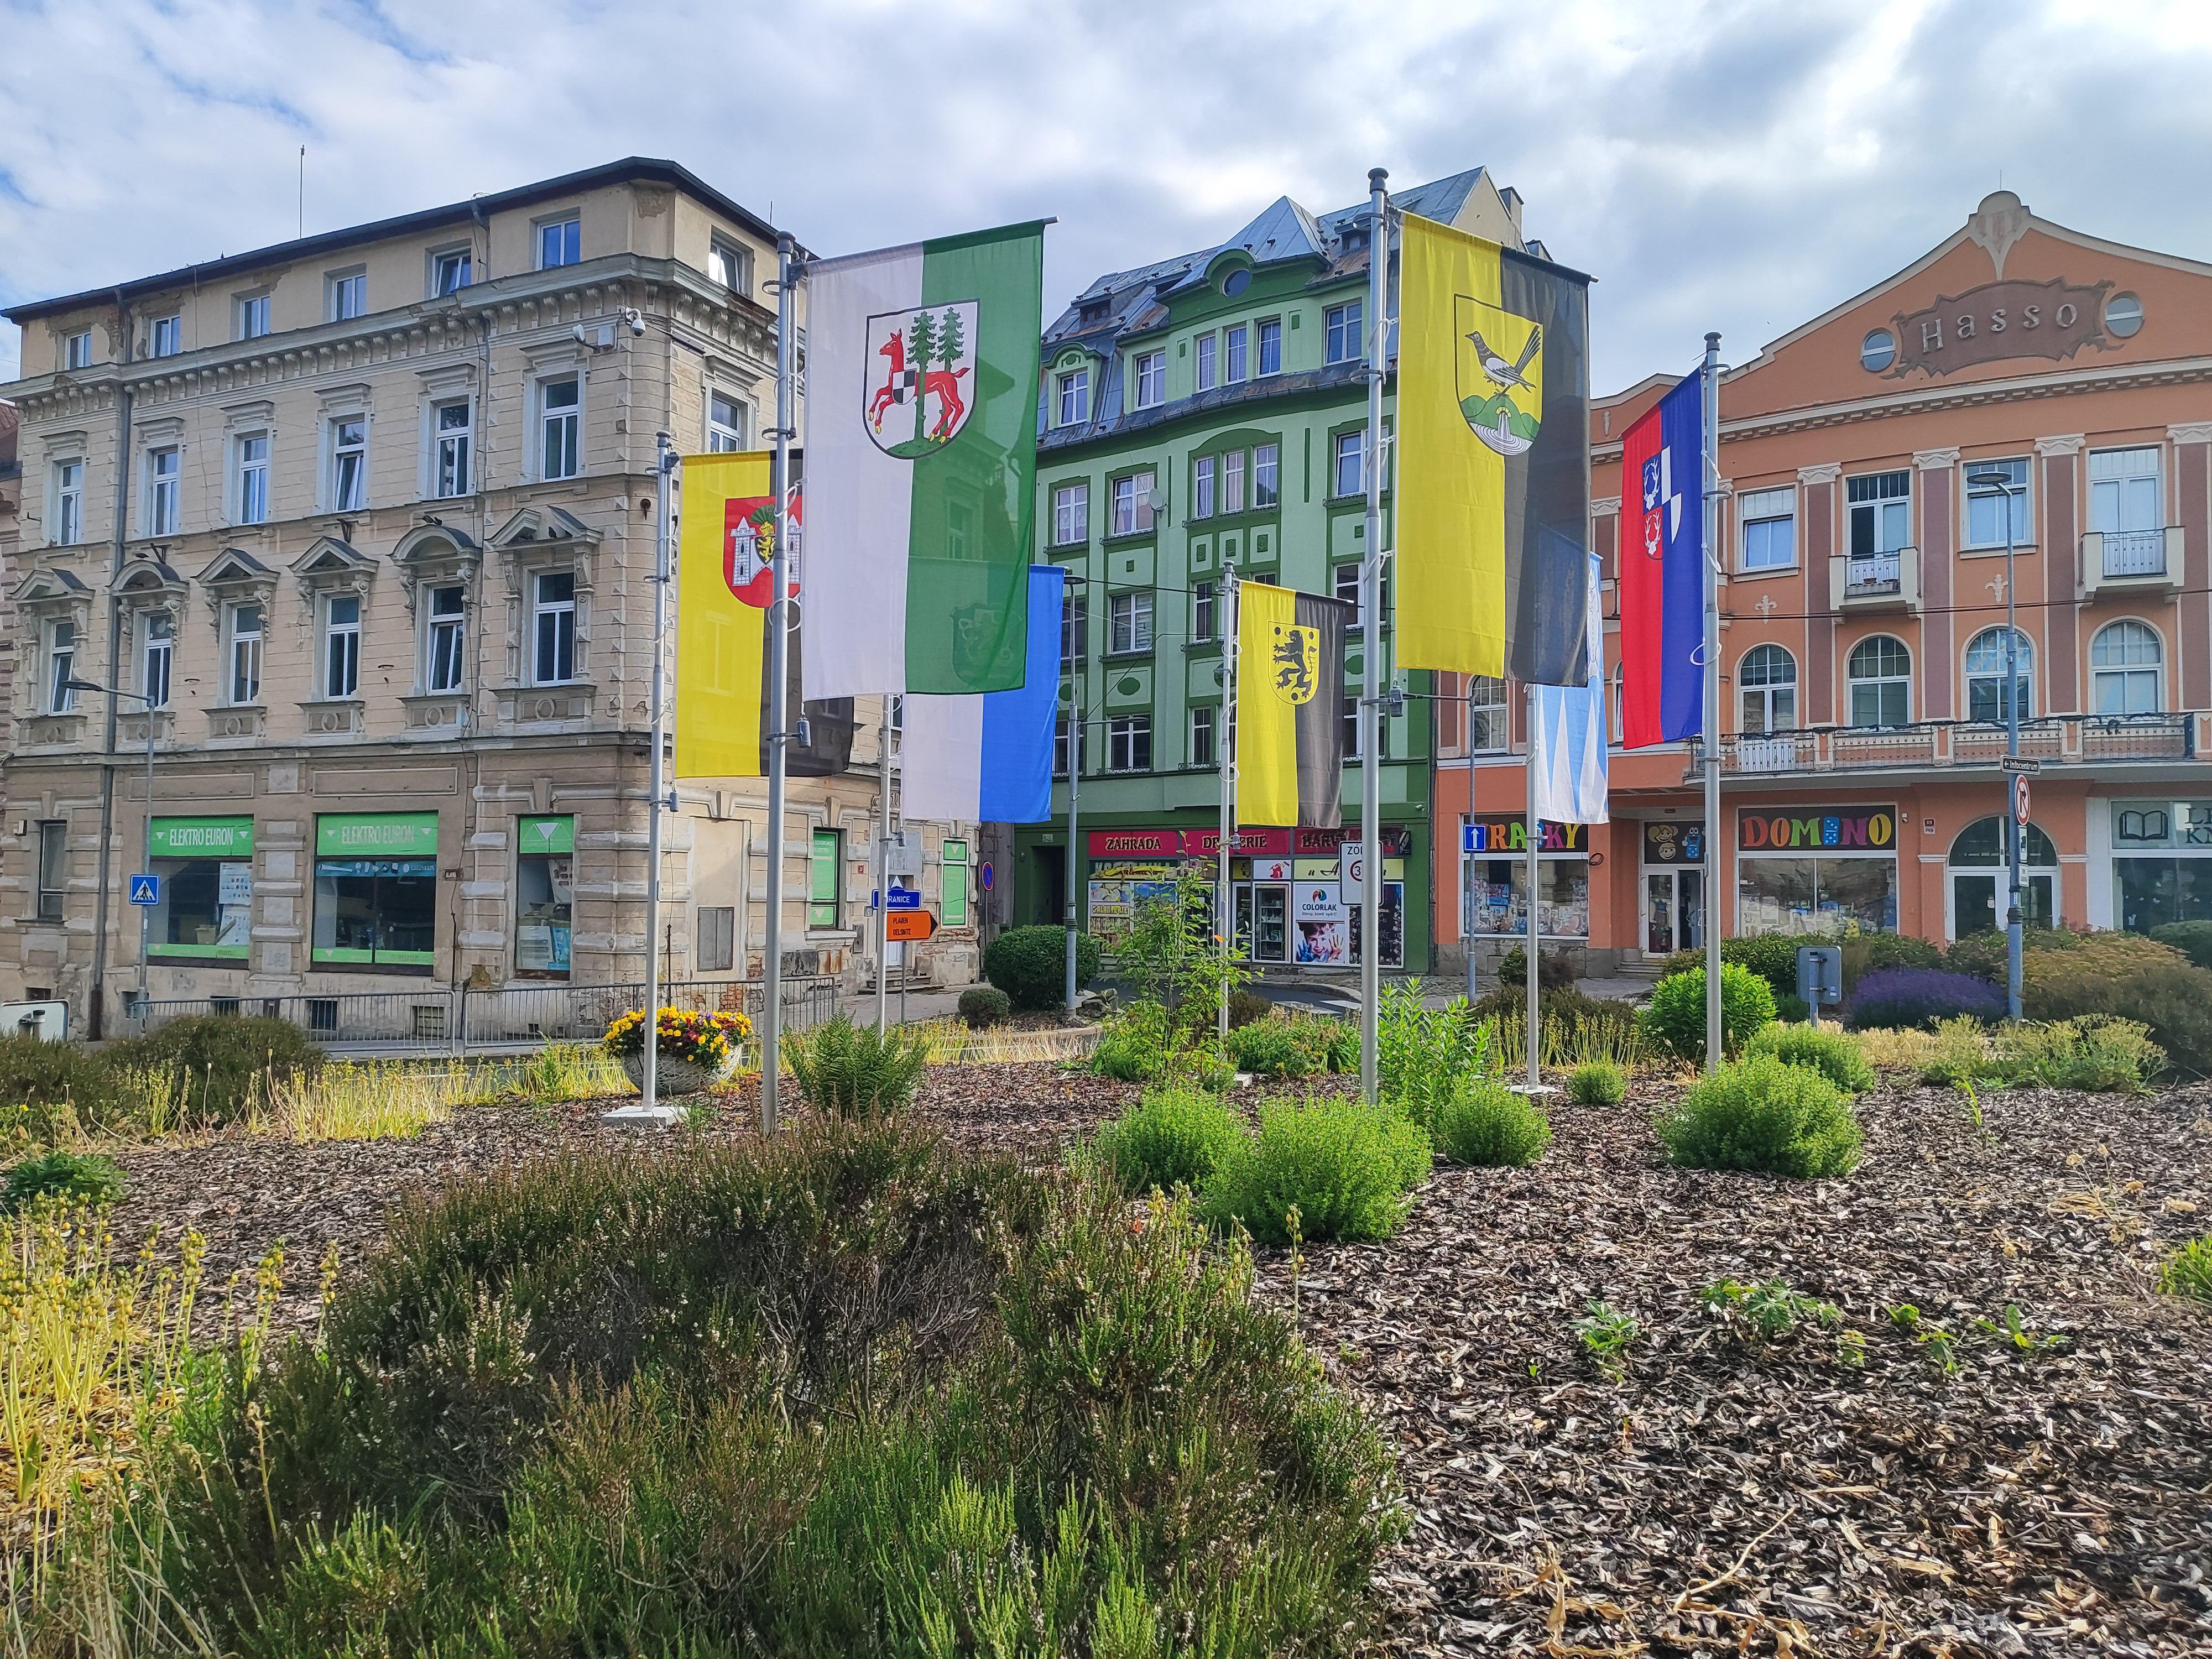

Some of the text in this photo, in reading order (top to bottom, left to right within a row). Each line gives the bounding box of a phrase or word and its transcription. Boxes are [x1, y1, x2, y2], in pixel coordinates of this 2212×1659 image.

[1920, 304, 2078, 354] Hasso
[2010, 760, 2038, 770] Infocentrum
[170, 828, 233, 846] ELEKTRO EURON
[342, 825, 414, 844] ELEKTRO EURON
[1202, 834, 1267, 849] DRERIE
[1480, 822, 1582, 850] RAKY
[1106, 837, 1162, 851] ZAHRADA
[1347, 843, 1362, 855] ZÓ
[1354, 865, 1361, 877] 3
